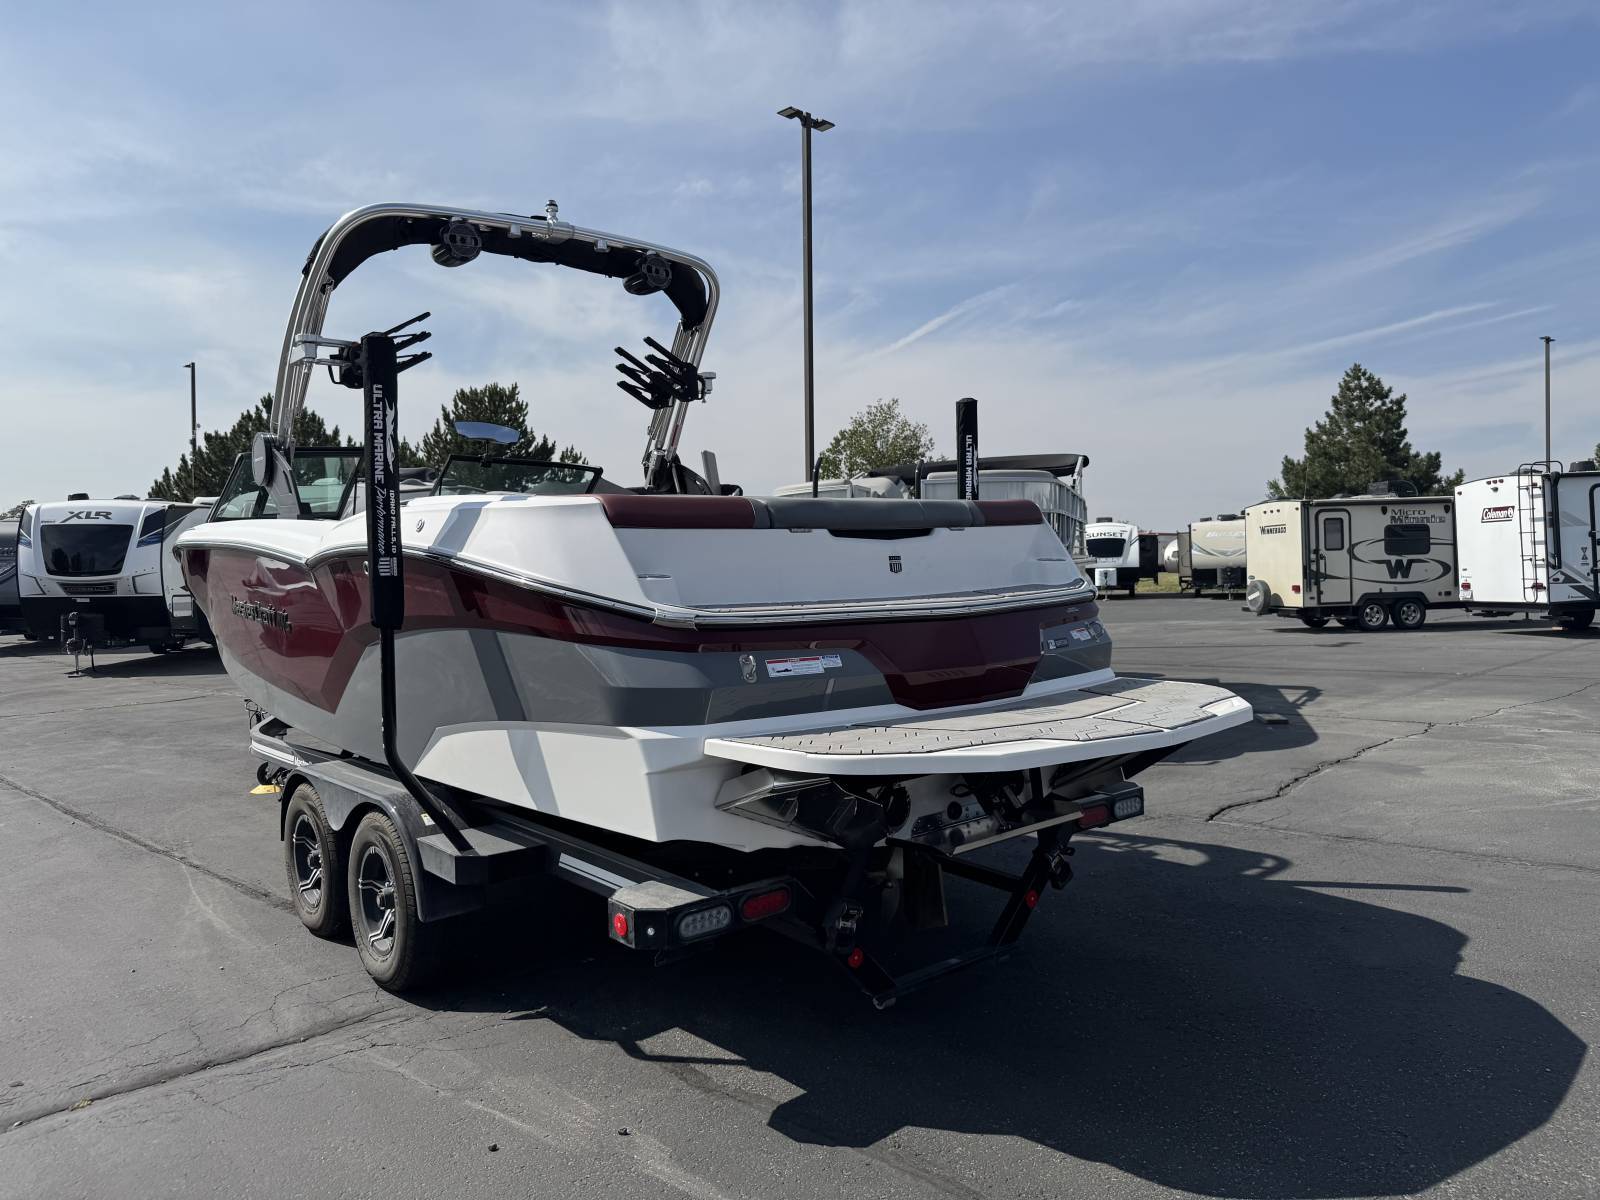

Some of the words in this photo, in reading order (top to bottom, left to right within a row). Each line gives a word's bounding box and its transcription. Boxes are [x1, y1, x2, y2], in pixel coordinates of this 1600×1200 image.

[373, 384, 384, 430] ULTRA
[374, 433, 385, 485] MARINE
[965, 434, 973, 466] ULTRA
[60, 511, 113, 523] XLR
[374, 485, 387, 556] Performance
[1483, 508, 1508, 520] Coleman
[391, 545, 397, 554] ID
